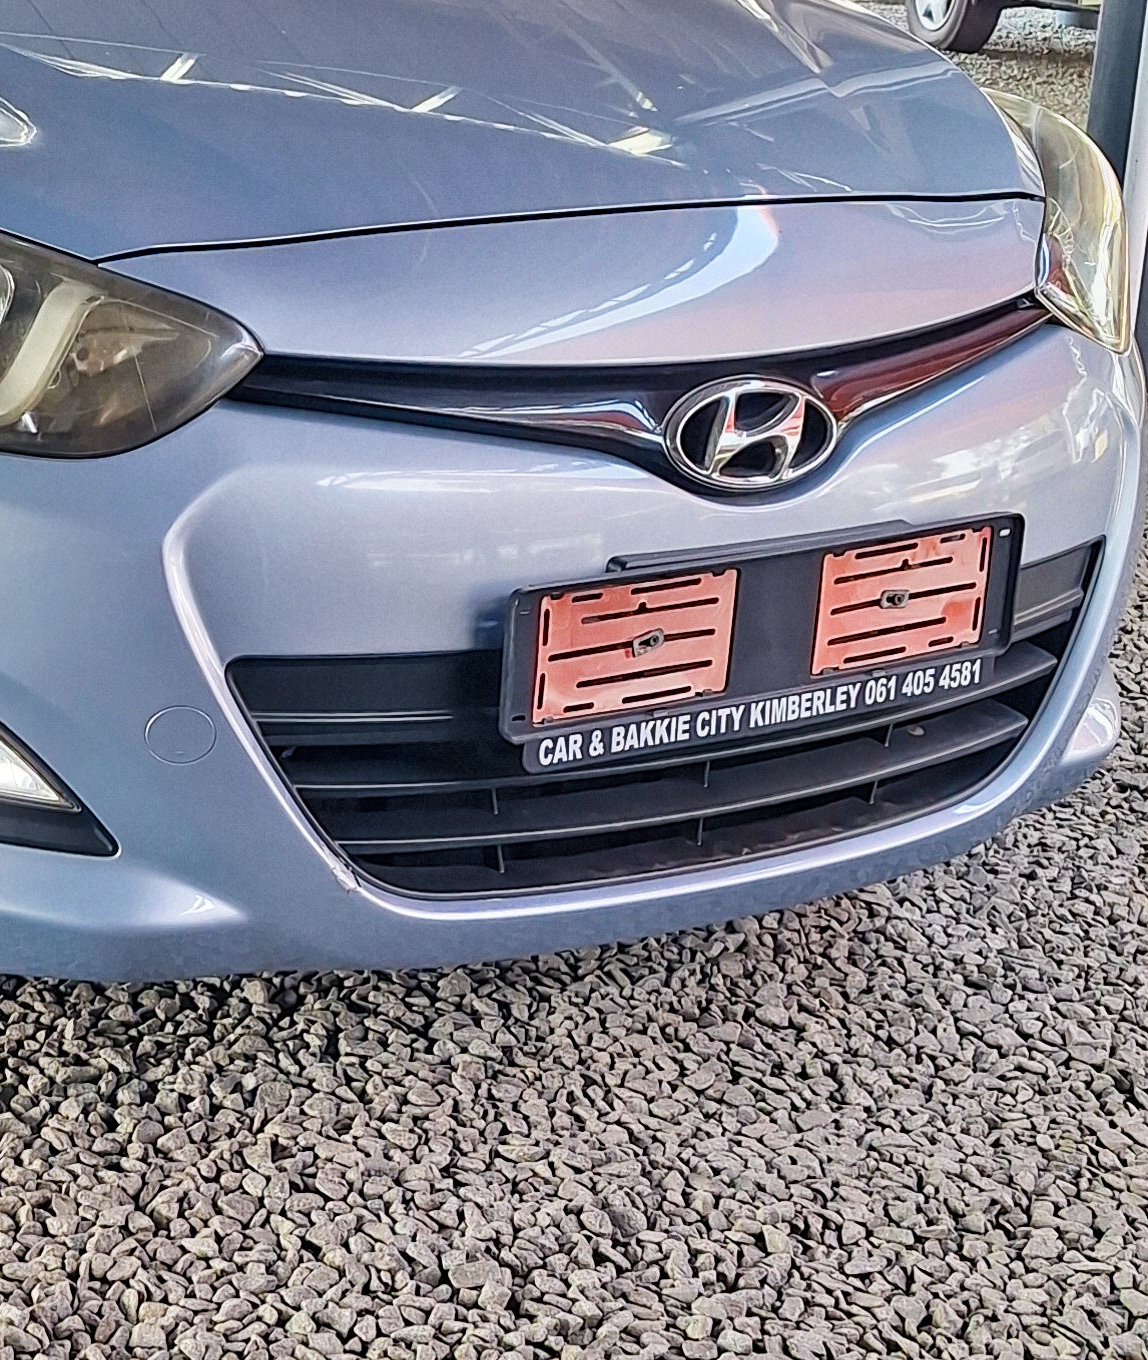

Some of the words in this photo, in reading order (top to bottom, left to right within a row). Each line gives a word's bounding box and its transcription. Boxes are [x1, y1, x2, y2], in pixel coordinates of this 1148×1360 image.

[538, 733, 585, 767] CAR
[589, 729, 605, 758] &
[611, 715, 692, 752] BAKKIE
[696, 703, 746, 738] CITY
[749, 683, 860, 728] KIMBERLEY
[864, 676, 896, 706] 061
[900, 667, 936, 697] 405
[938, 658, 982, 691] 4581
